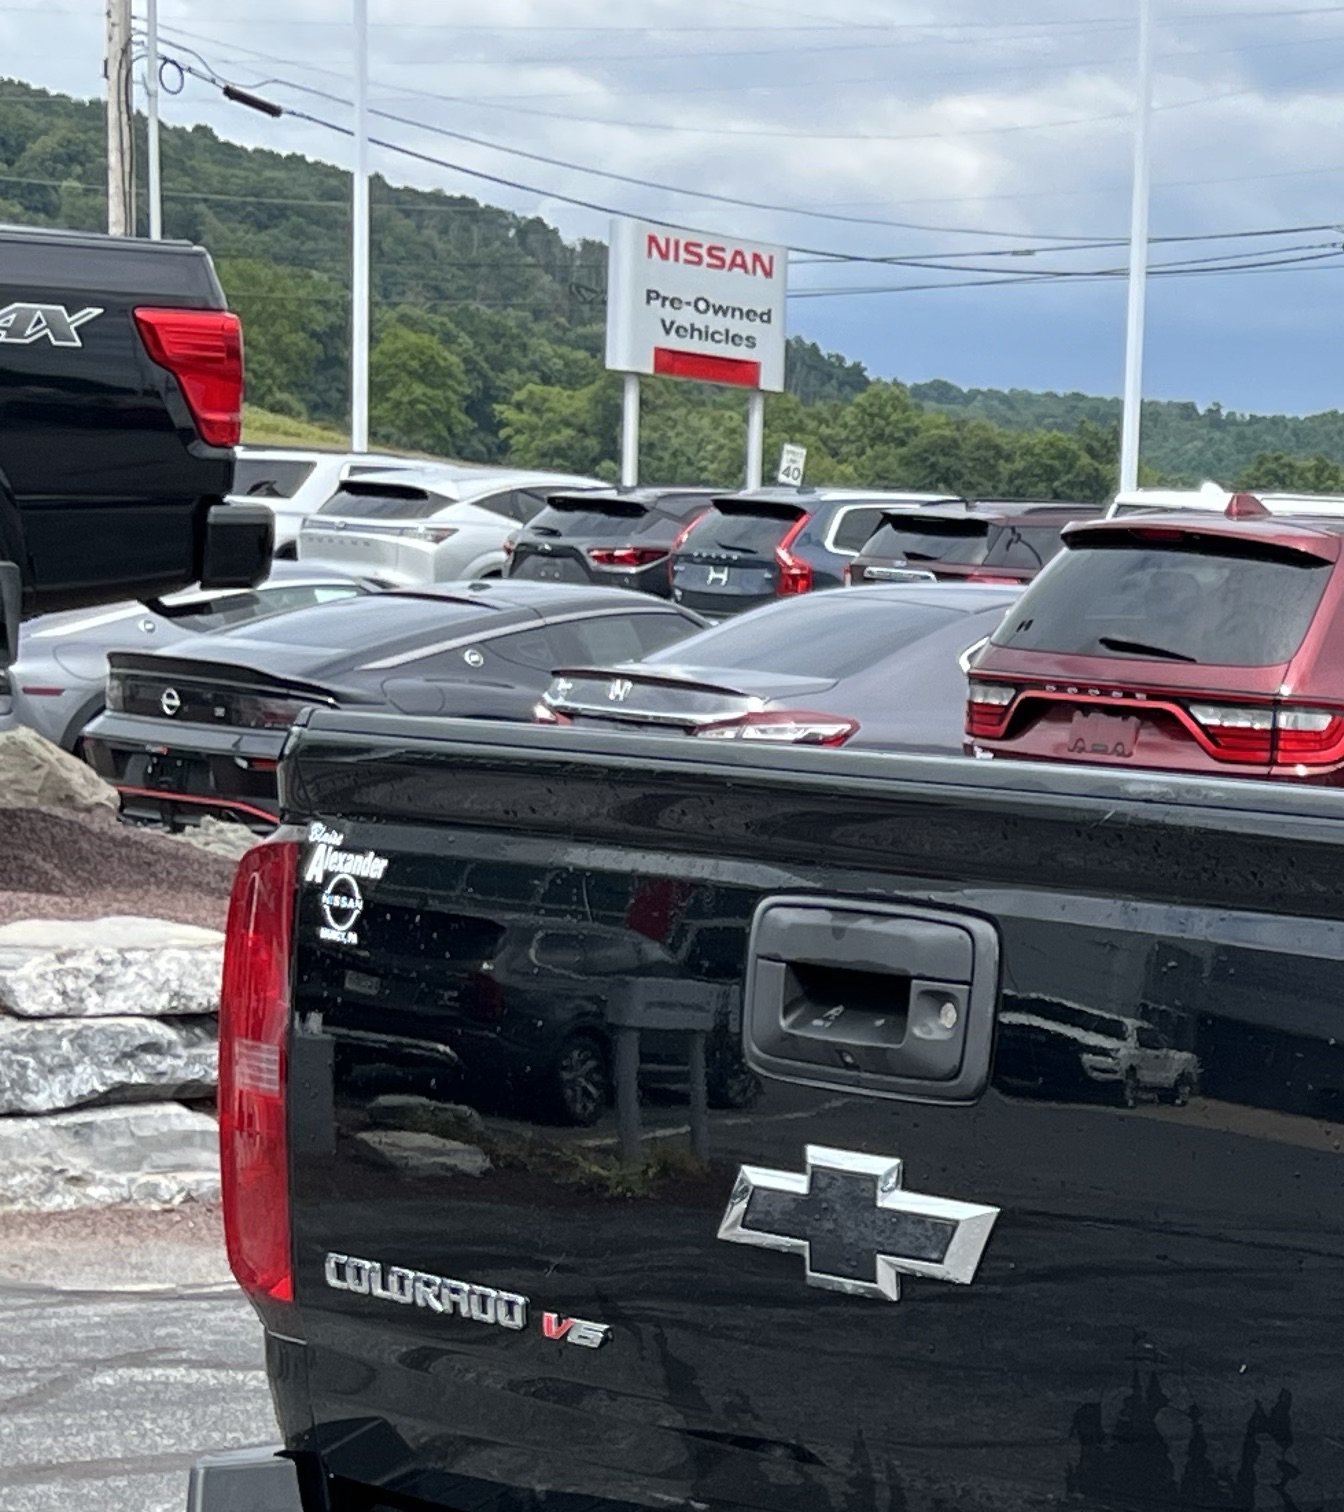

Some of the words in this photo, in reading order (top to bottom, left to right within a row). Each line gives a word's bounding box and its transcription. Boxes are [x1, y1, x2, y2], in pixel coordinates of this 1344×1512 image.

[646, 233, 775, 279] NISSAN
[645, 288, 773, 324] Pre-Owned
[660, 318, 758, 349] Vehicles
[782, 466, 801, 481] 40
[304, 843, 389, 884] Alexander
[322, 893, 363, 911] NISSAN
[325, 1252, 531, 1330] COLORADO
[543, 1312, 614, 1348] V6
